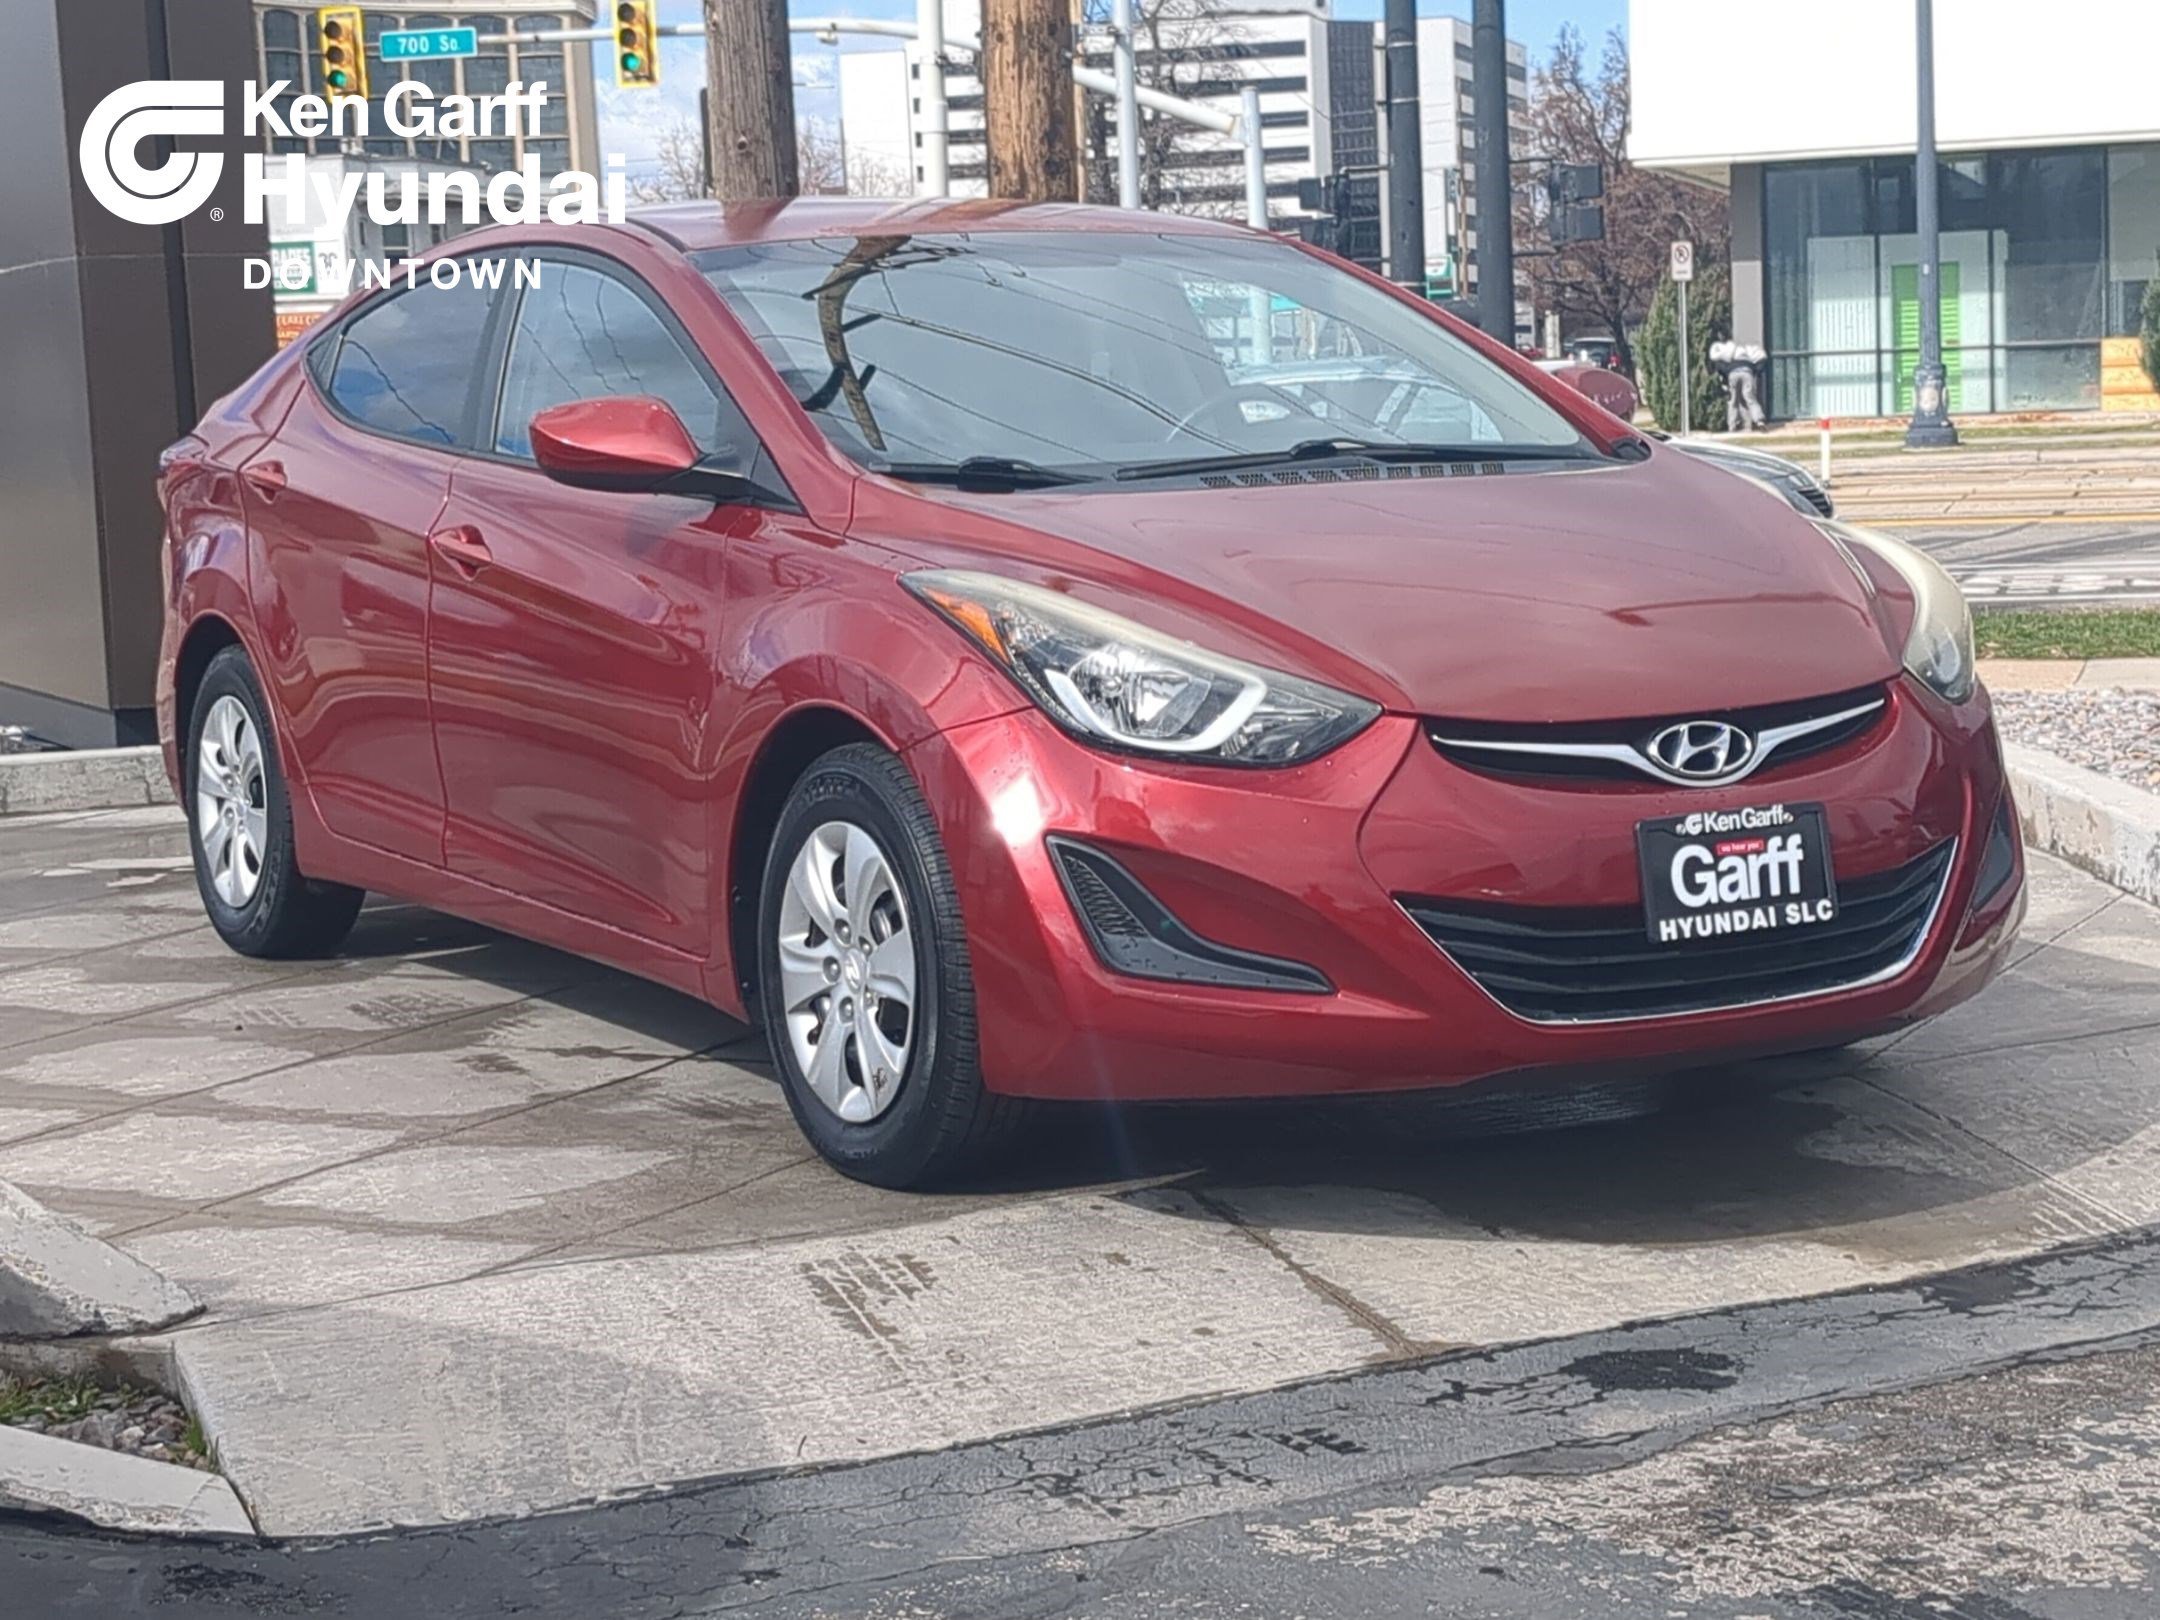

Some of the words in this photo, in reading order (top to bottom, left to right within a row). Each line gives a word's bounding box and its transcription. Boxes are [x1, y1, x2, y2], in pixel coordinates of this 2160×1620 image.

[397, 36, 430, 54] 700
[1704, 811, 1741, 833] Ken
[1741, 804, 1784, 829] Garff
[1670, 834, 1804, 907] Garff
[1659, 907, 1777, 941] HYUNDAI
[1785, 899, 1834, 925] SLC
